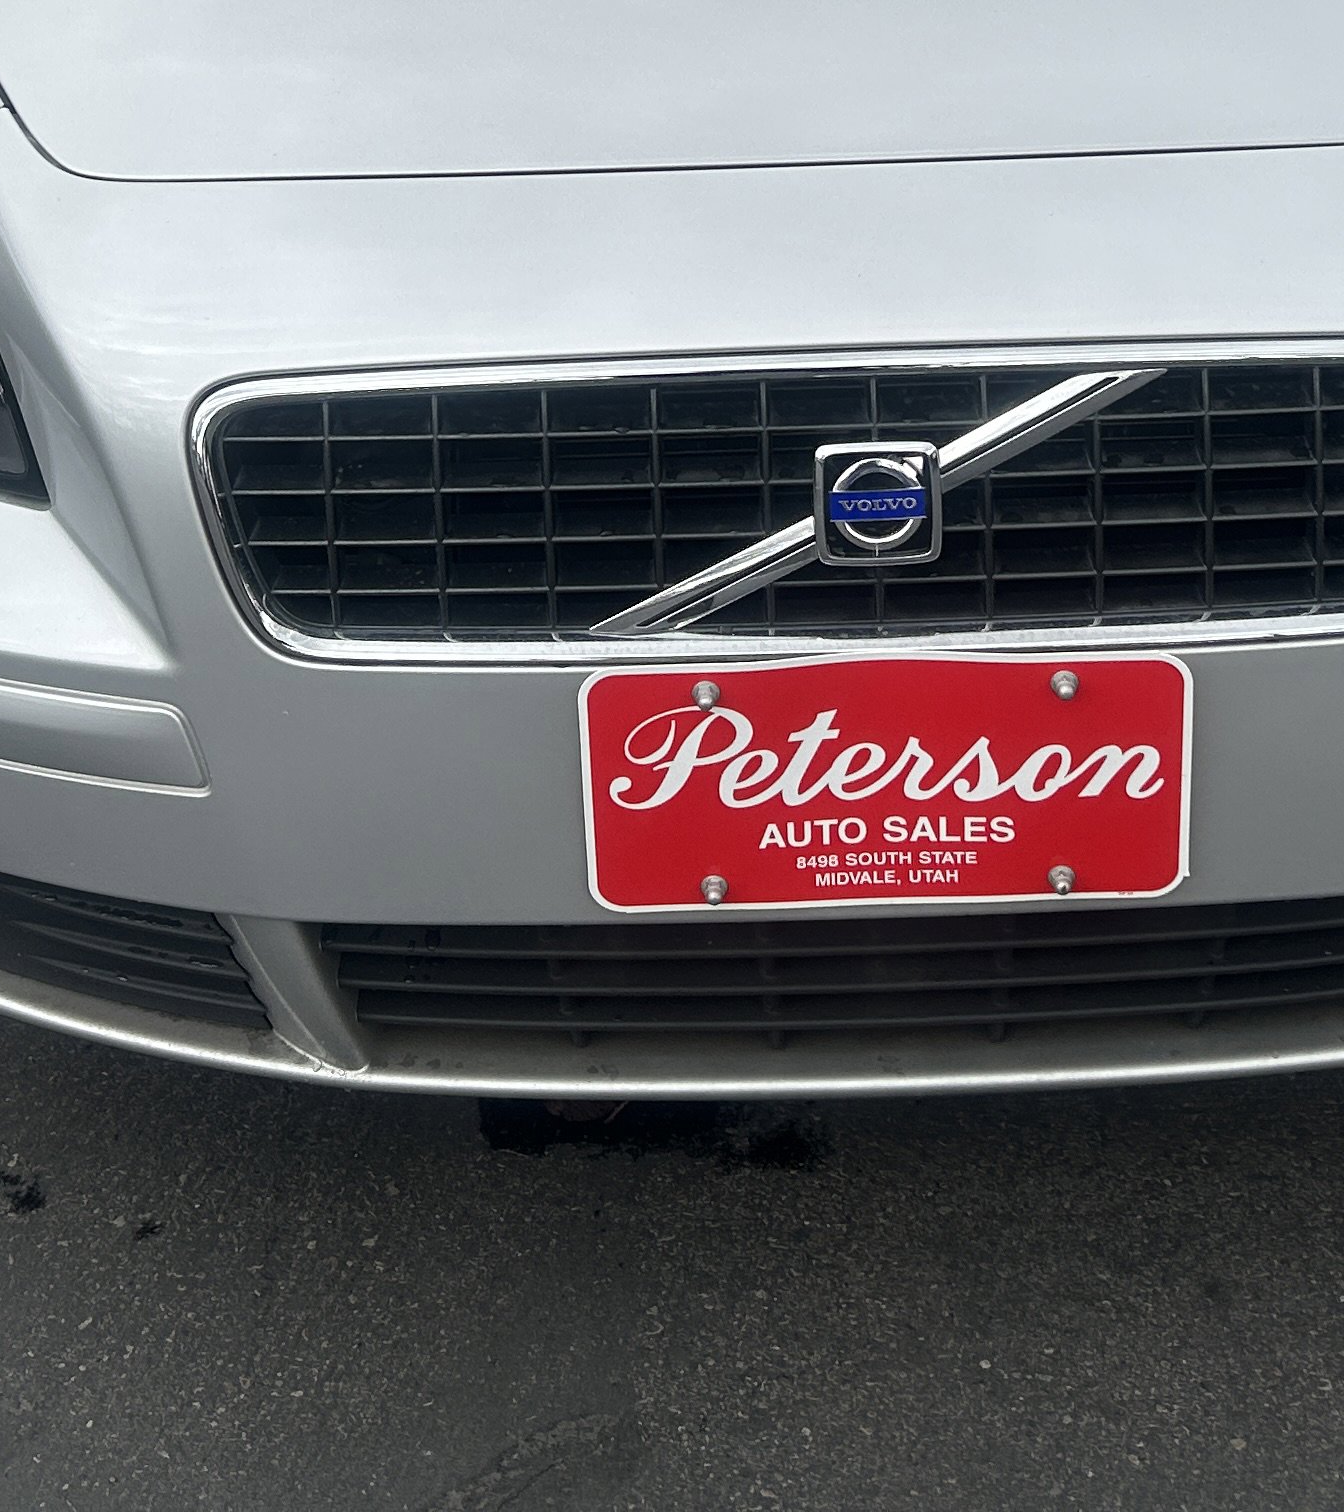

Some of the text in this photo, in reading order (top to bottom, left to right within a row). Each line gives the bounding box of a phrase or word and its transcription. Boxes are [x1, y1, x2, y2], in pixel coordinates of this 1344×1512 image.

[838, 497, 917, 512] VOLVO
[608, 704, 1165, 810] Peterson
[758, 815, 1016, 850] AUTO SALES
[796, 850, 978, 869] 8498 SOUTH STATE
[815, 869, 959, 887] MIDVALE, UTAH
